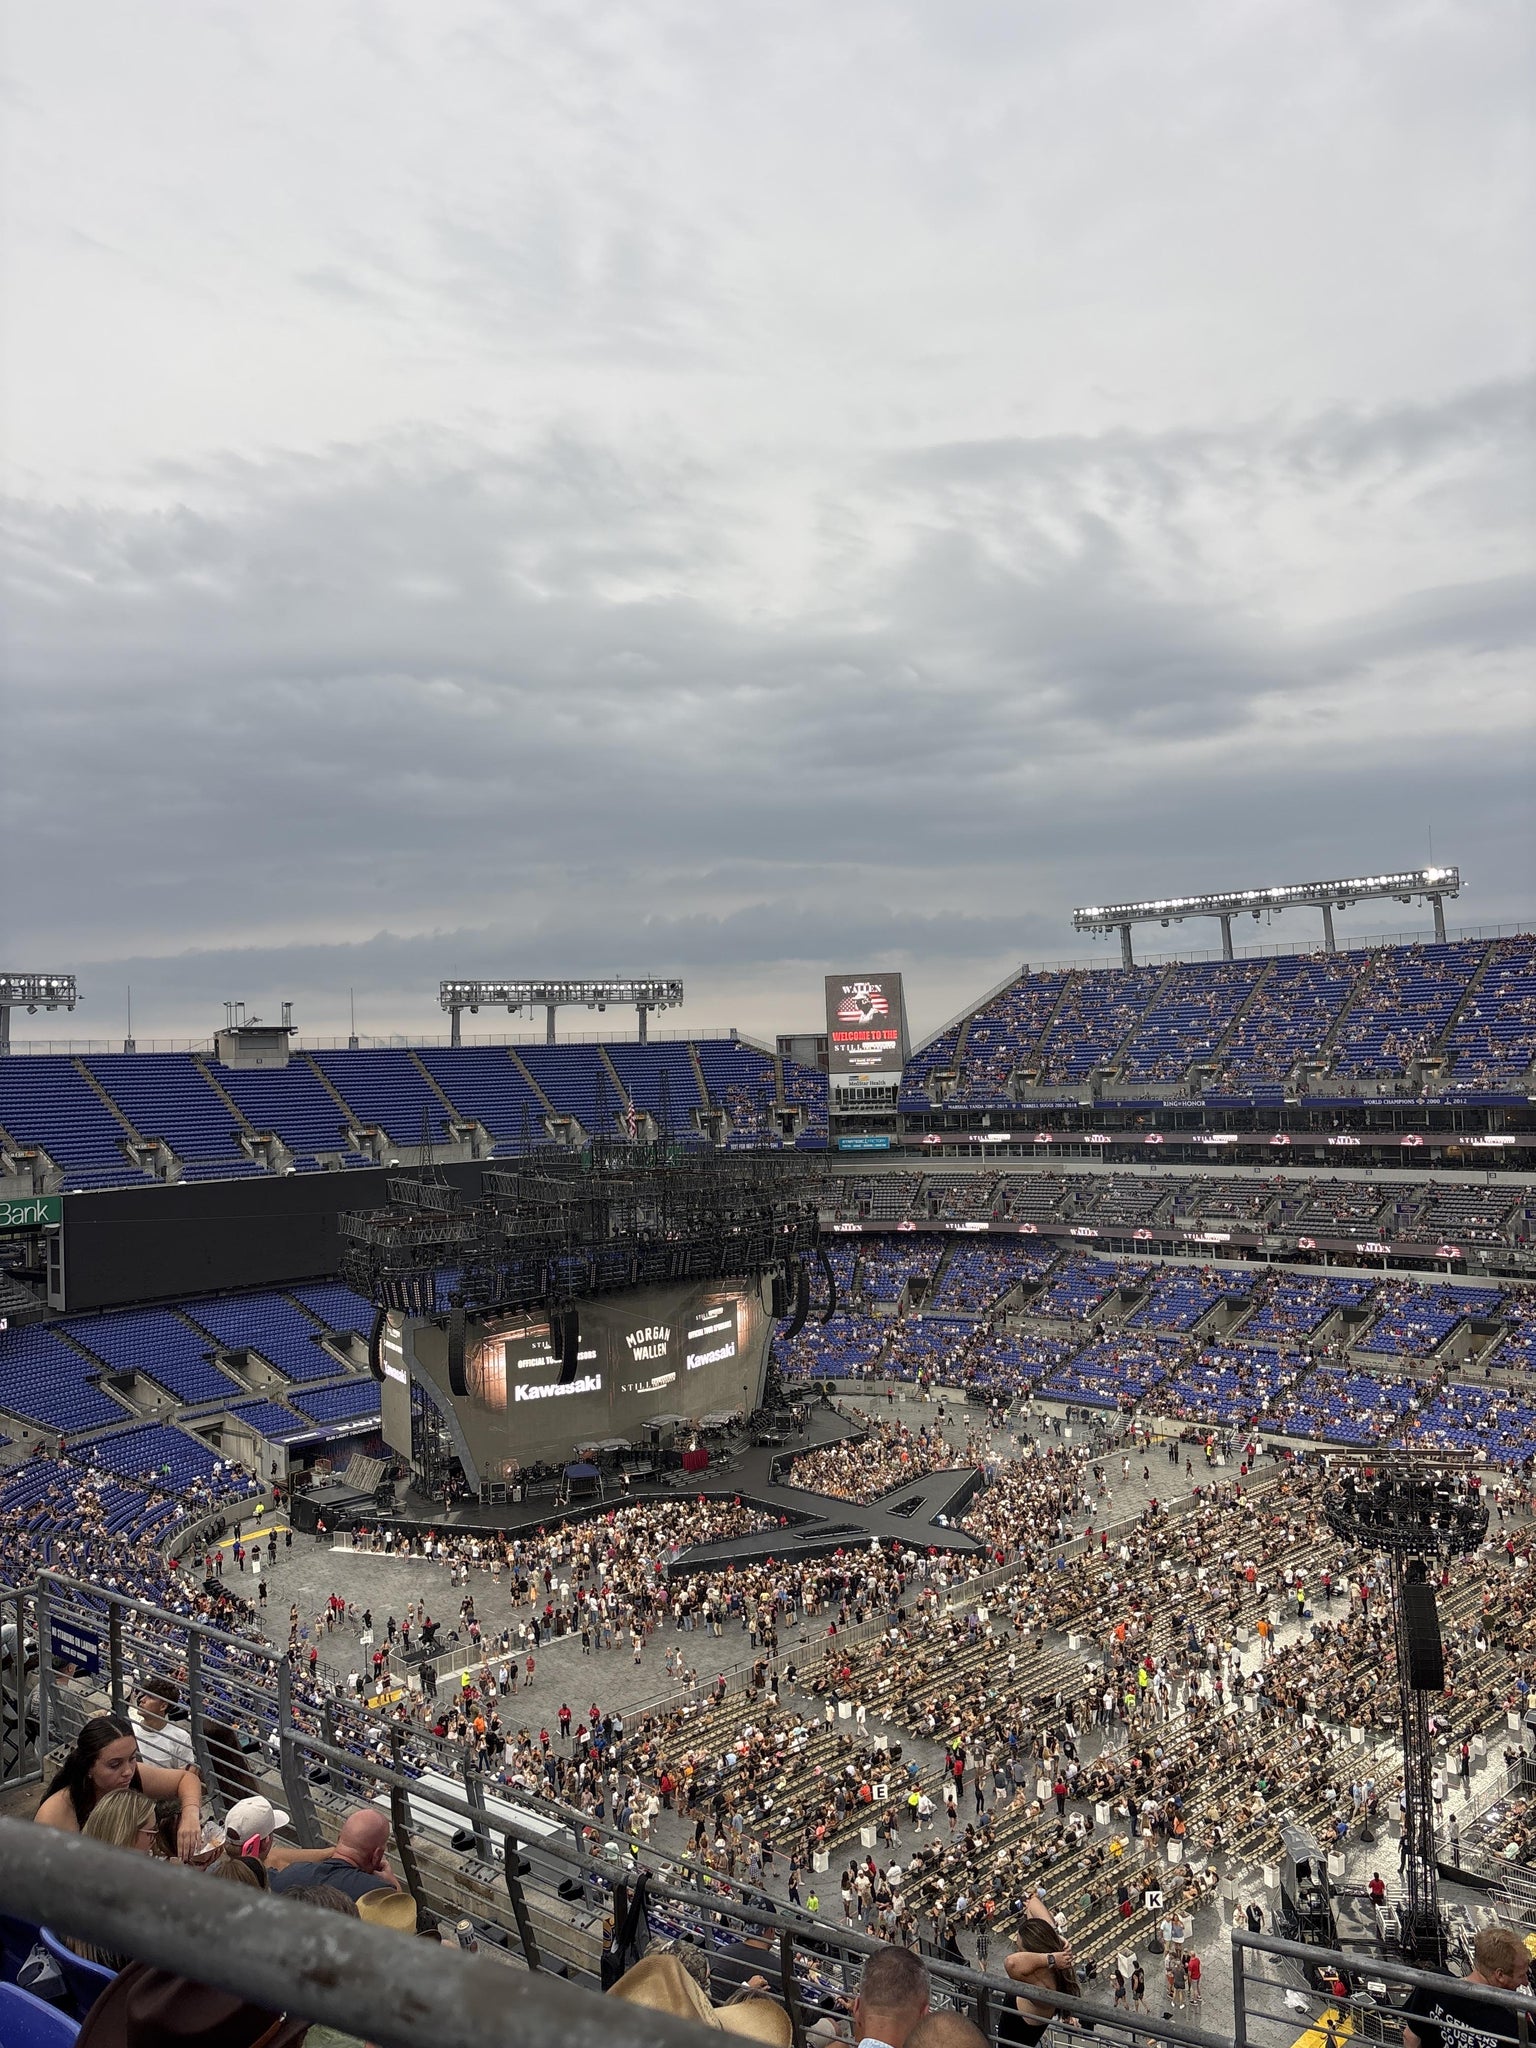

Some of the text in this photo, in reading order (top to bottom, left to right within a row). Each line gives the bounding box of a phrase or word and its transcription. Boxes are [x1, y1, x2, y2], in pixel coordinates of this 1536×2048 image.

[832, 1030, 898, 1041] WELCOME TO THE
[625, 1326, 671, 1349] MORGAN
[633, 1342, 667, 1361] WALLEN
[686, 1341, 735, 1370] Kawasaki
[517, 1358, 545, 1368] OFFICIAL
[515, 1374, 601, 1401] Kawasaki
[621, 1381, 651, 1392] STILL
[877, 1786, 885, 1798] E
[1150, 1894, 1161, 1907] K
[1435, 2004, 1443, 2016] IF
[1441, 2030, 1454, 2045] GO
